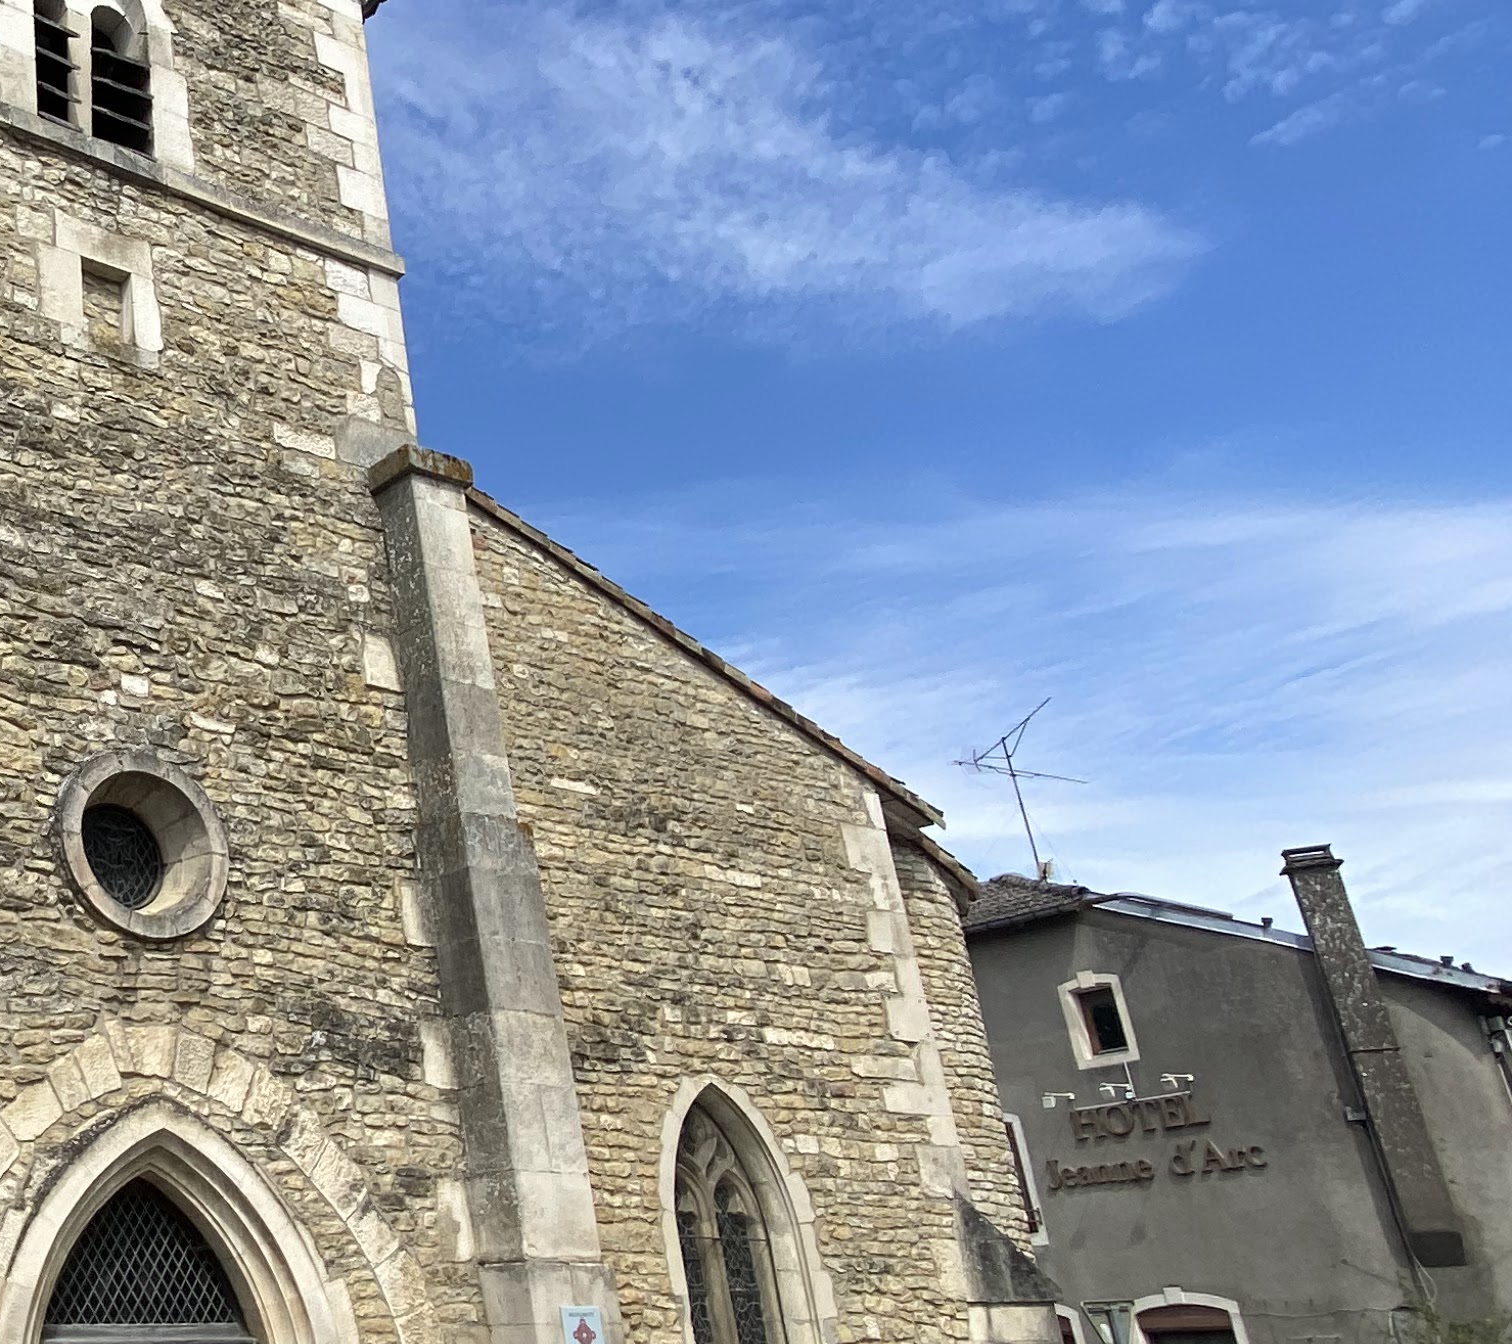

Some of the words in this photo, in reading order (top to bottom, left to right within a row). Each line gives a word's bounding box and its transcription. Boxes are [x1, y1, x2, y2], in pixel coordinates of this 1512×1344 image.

[1070, 1096, 1211, 1142] HOTEL
[1045, 1159, 1155, 1191] Jeanne
[1169, 1139, 1269, 1177] d'Arc
